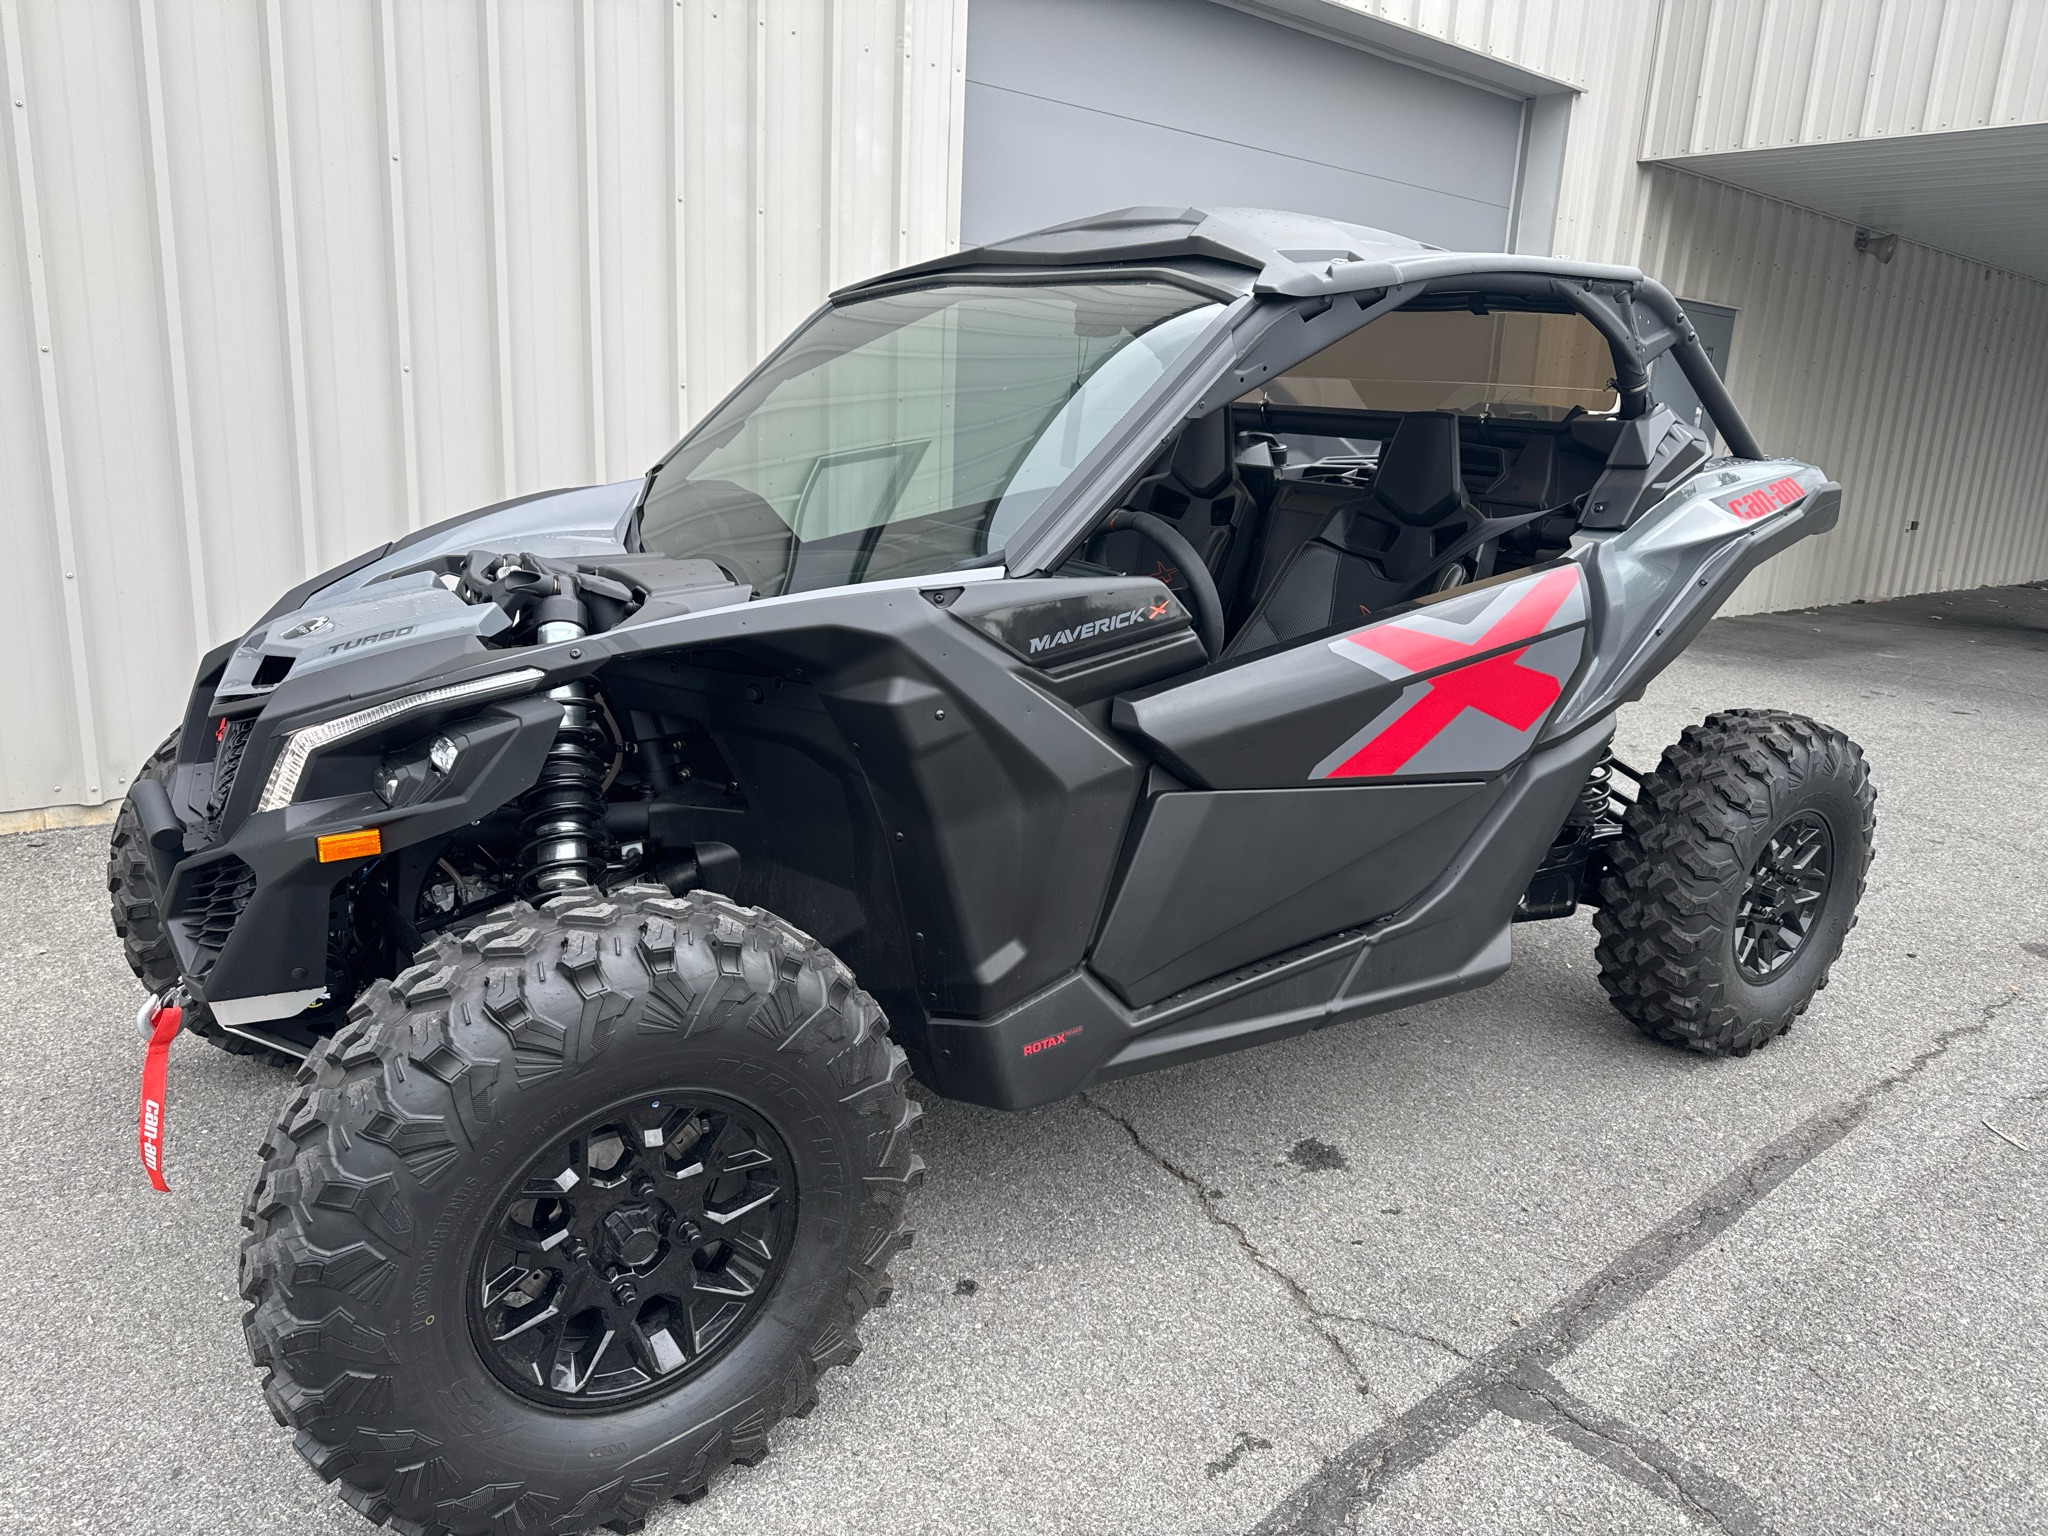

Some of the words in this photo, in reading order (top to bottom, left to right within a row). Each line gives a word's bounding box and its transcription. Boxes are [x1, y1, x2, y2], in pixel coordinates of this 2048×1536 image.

[1728, 477, 1806, 521] can-am
[329, 625, 415, 654] TURBO
[1029, 607, 1146, 654] MAVERICK
[1023, 1033, 1066, 1056] ROTAX
[143, 1099, 160, 1172] can-am
